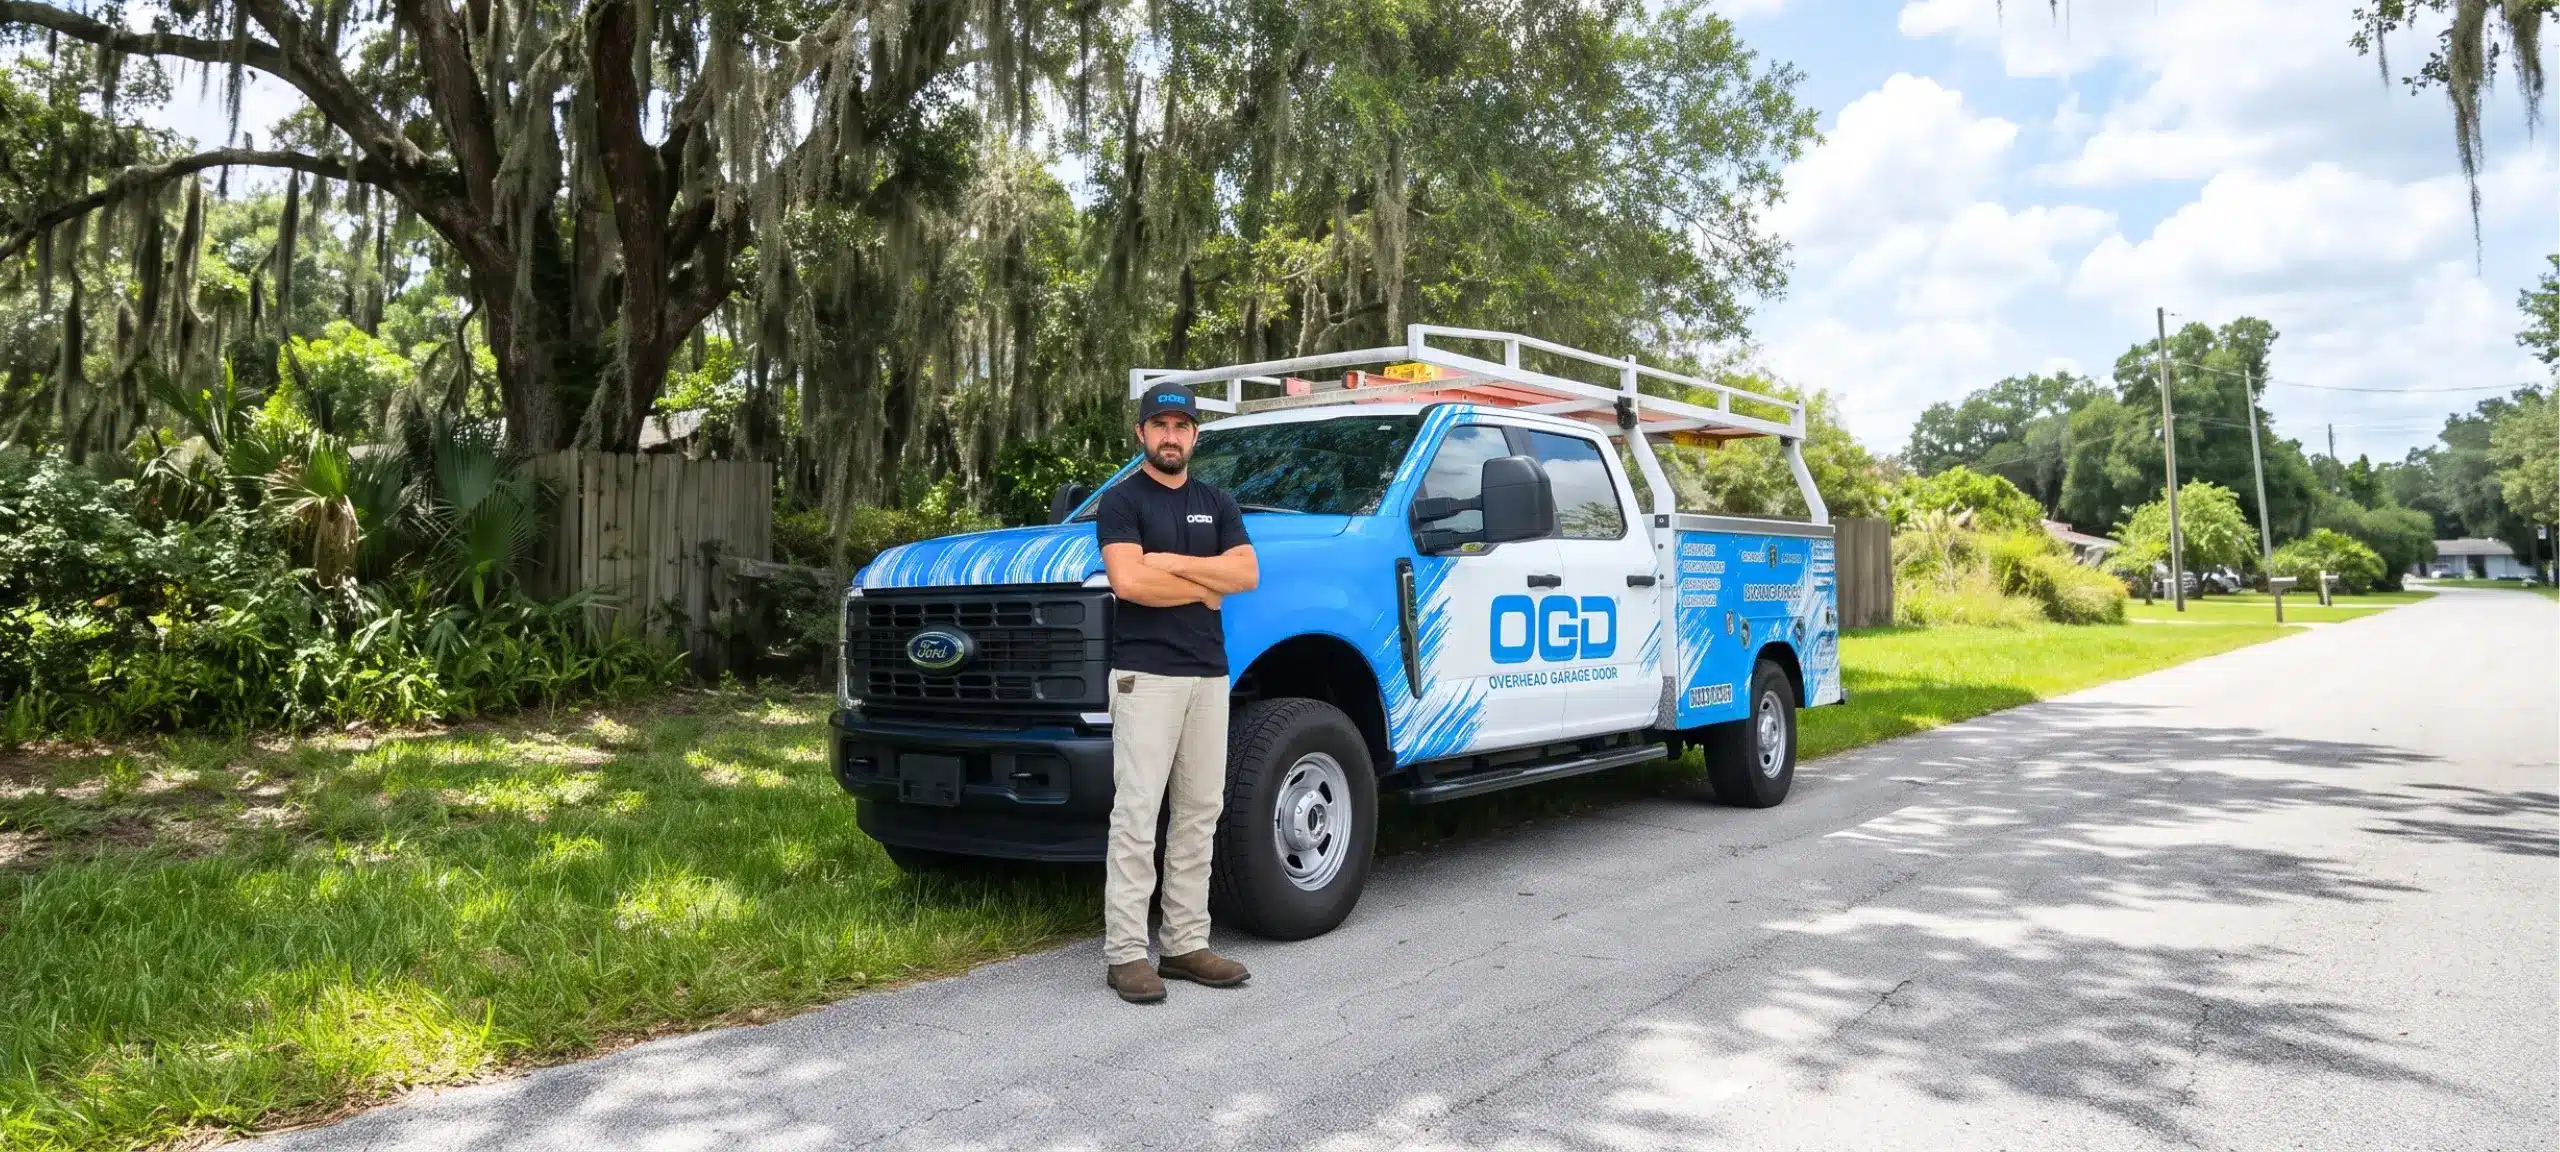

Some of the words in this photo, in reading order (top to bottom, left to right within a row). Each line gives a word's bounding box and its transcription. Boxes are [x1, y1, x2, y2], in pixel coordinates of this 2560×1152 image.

[1490, 594, 1616, 664] OGD
[917, 640, 947, 658] Ford
[1489, 674, 1548, 689] OVERHEAD
[1550, 669, 1590, 684] GARAGE
[1592, 667, 1618, 680] DOOR
